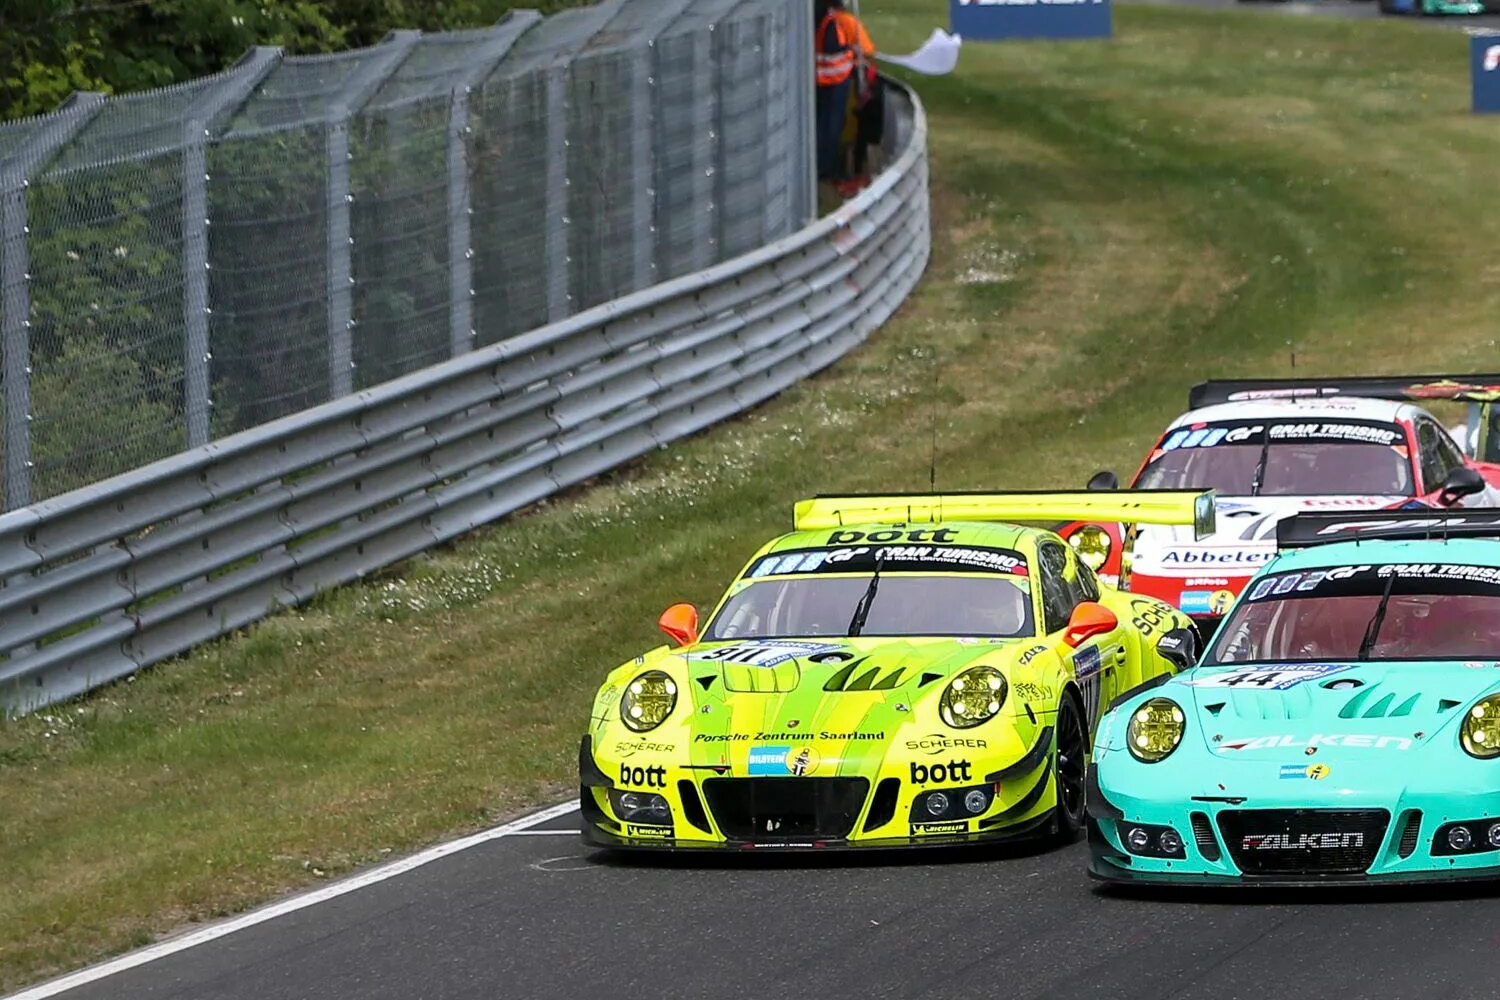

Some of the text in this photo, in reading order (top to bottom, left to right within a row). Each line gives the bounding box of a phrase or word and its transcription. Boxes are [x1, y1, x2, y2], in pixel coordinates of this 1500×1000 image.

[1269, 424, 1320, 435] GRAN
[826, 527, 960, 545] bott
[920, 555, 957, 564] DRIVING
[958, 559, 1012, 573] SIMULATOR
[1377, 565, 1437, 574] GRAN
[1249, 571, 1326, 600] 002
[1218, 672, 1283, 686] 44
[694, 731, 885, 743] Porsche Zentrum Saarland
[905, 738, 988, 751] SCHERER
[1216, 733, 1415, 752] FALKEN
[614, 741, 676, 754] SCHERER
[620, 762, 667, 788] bott
[910, 759, 972, 785] bott
[1242, 832, 1364, 850] FALKEN
